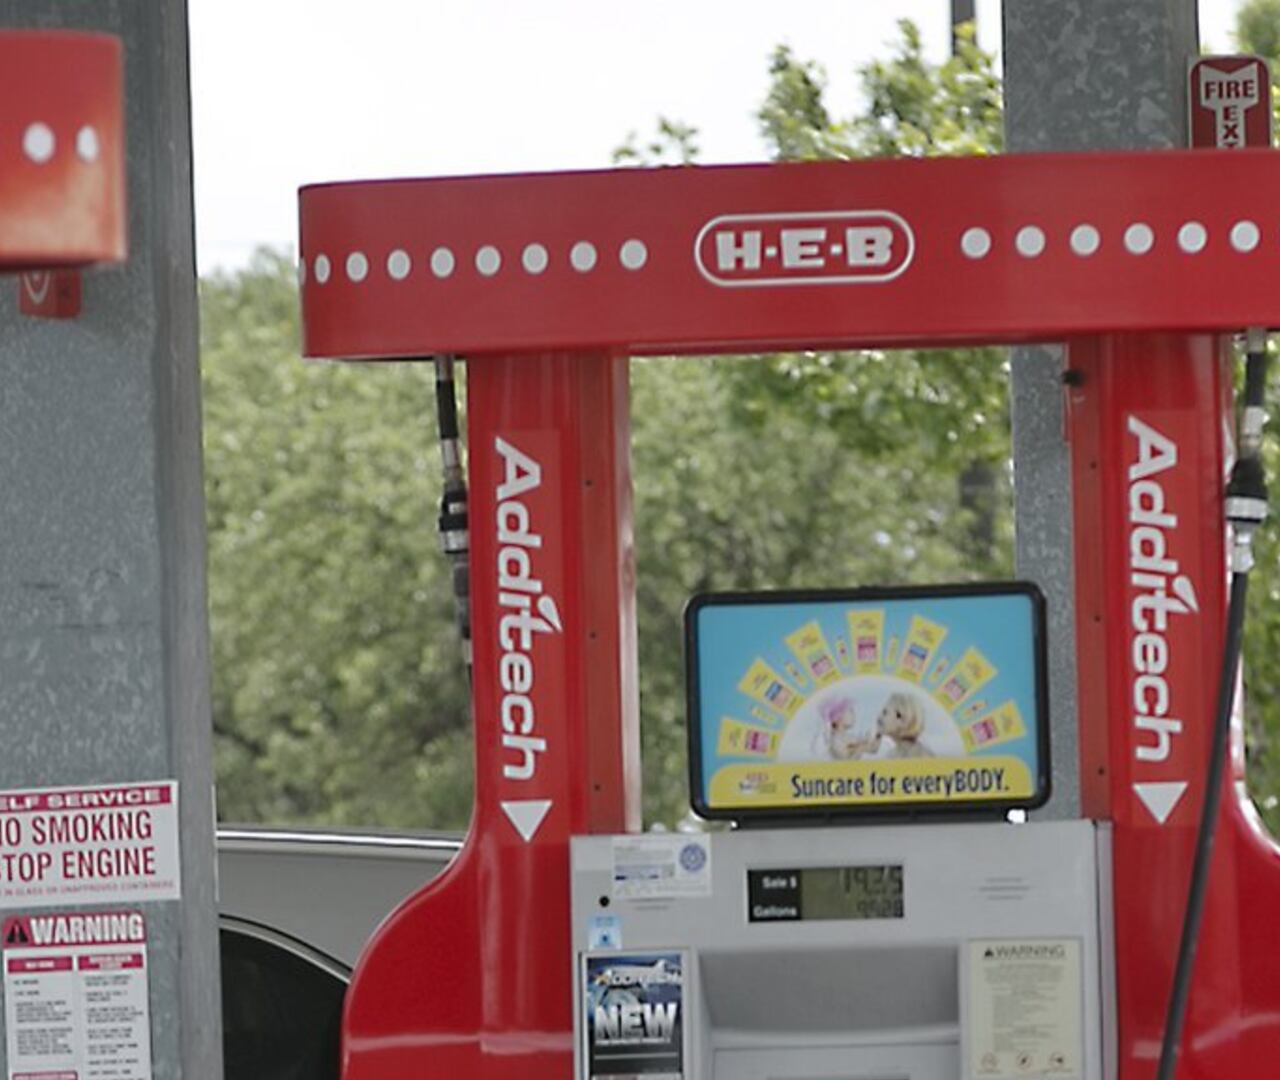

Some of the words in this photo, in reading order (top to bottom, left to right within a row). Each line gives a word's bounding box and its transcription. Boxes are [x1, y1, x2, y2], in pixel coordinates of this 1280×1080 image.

[1204, 80, 1255, 99] FIRE
[1127, 415, 1199, 763] Additech
[494, 435, 563, 781] Additech
[47, 786, 161, 807] SERVICE
[791, 774, 864, 799] Suncare
[869, 772, 895, 795] for
[902, 767, 1010, 798] everyBODY.
[30, 809, 152, 847] SMOKING
[61, 845, 156, 880] ENGINE
[753, 905, 798, 919] Gallons
[30, 914, 144, 945] WARNING
[996, 944, 1065, 958] WARNING
[594, 1001, 678, 1041] NEW
